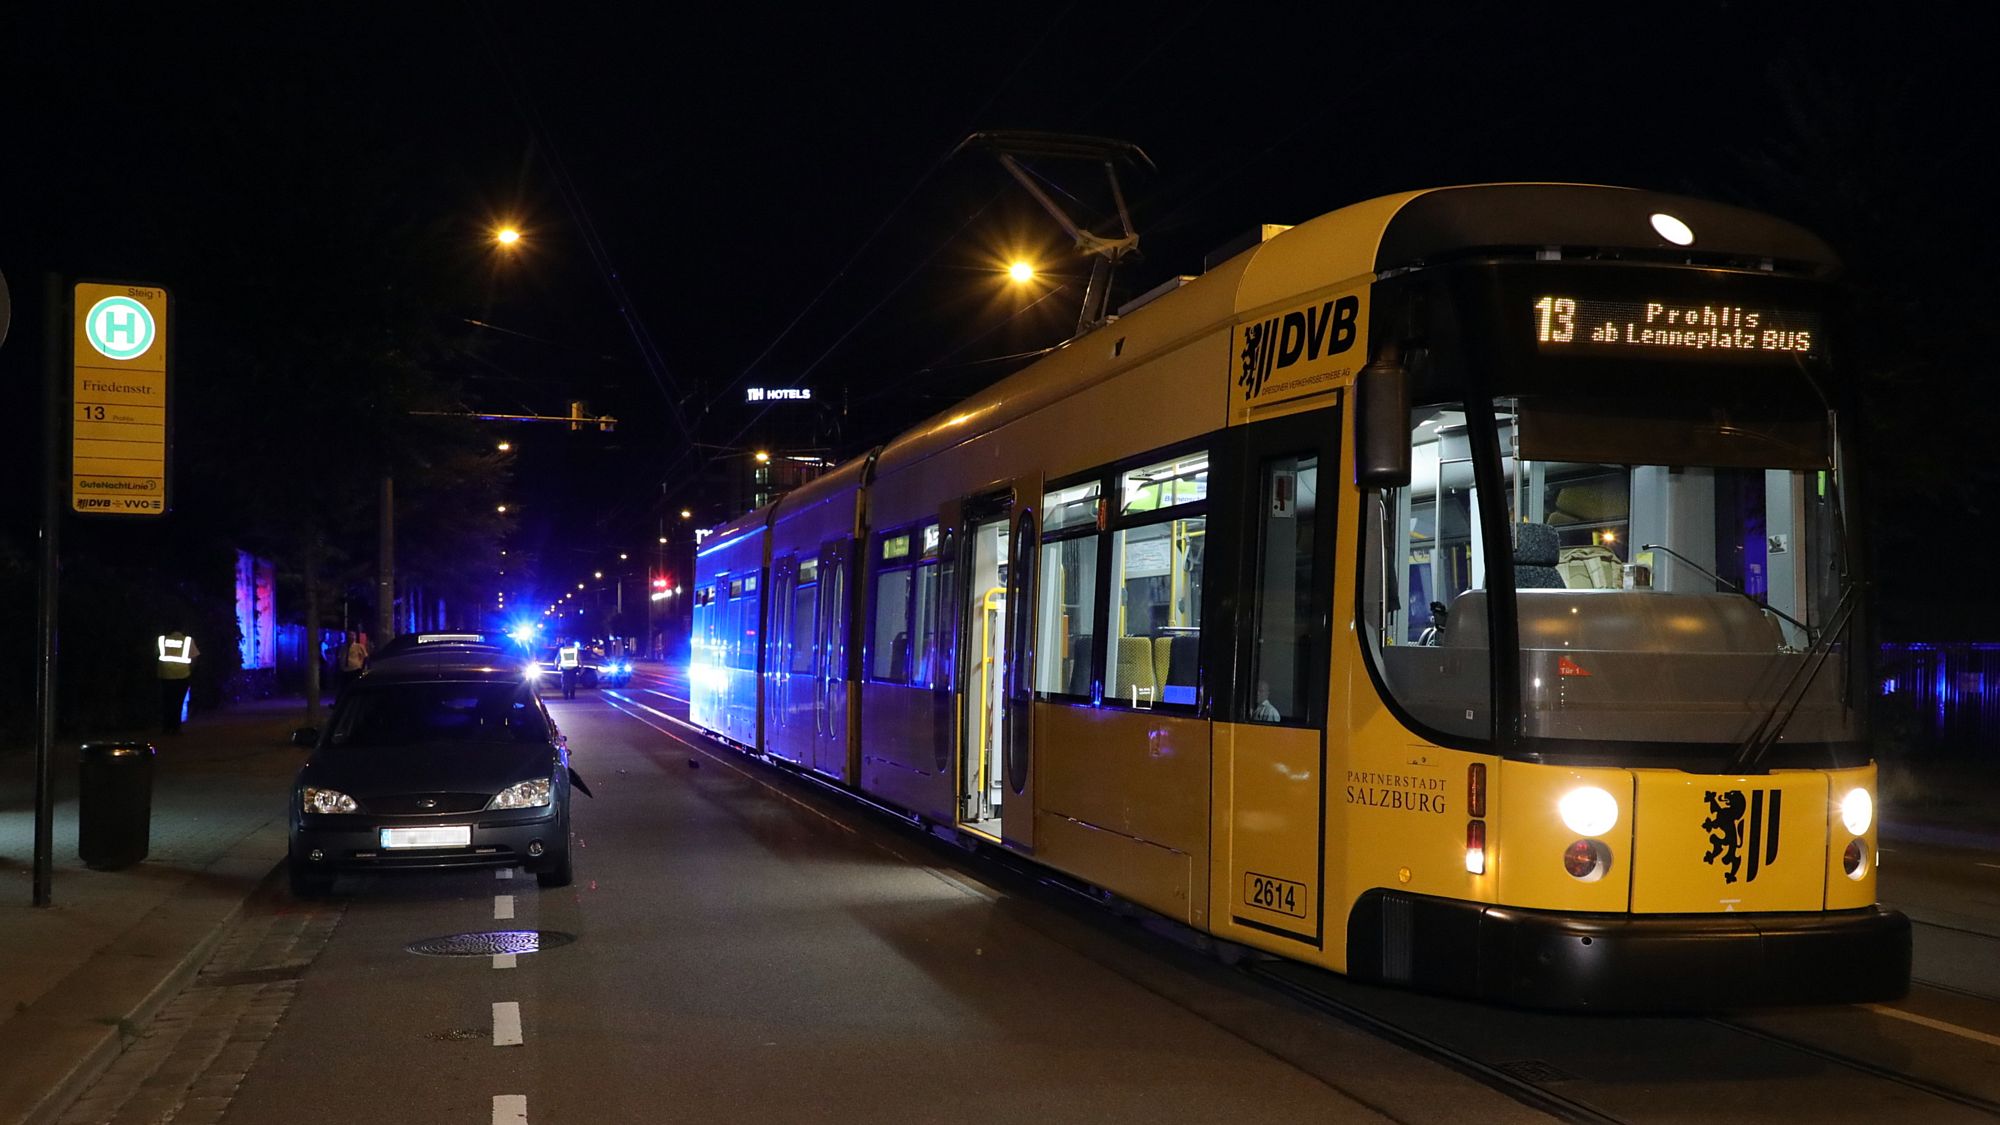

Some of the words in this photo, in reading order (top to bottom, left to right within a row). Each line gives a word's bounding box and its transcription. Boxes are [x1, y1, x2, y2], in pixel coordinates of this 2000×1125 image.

[128, 287, 153, 299] Steig
[1535, 297, 1576, 343] 13
[1647, 303, 1759, 328] Prohlis
[106, 311, 136, 344] H
[1277, 295, 1359, 369] DVB
[1592, 322, 1618, 342] ab
[1627, 323, 1755, 349] Lenneplatz
[1762, 330, 1810, 351] BUS
[83, 380, 156, 395] Friedensstr.
[767, 388, 811, 400] HOTELS
[83, 406, 105, 420] 13
[80, 481, 148, 491] GuteNachtLinie
[89, 499, 111, 507] DVB
[124, 500, 149, 508] VVO
[1347, 770, 1447, 791] PARTNERSTADT
[1346, 785, 1446, 814] SALZBURG
[1253, 877, 1295, 912] 2614
